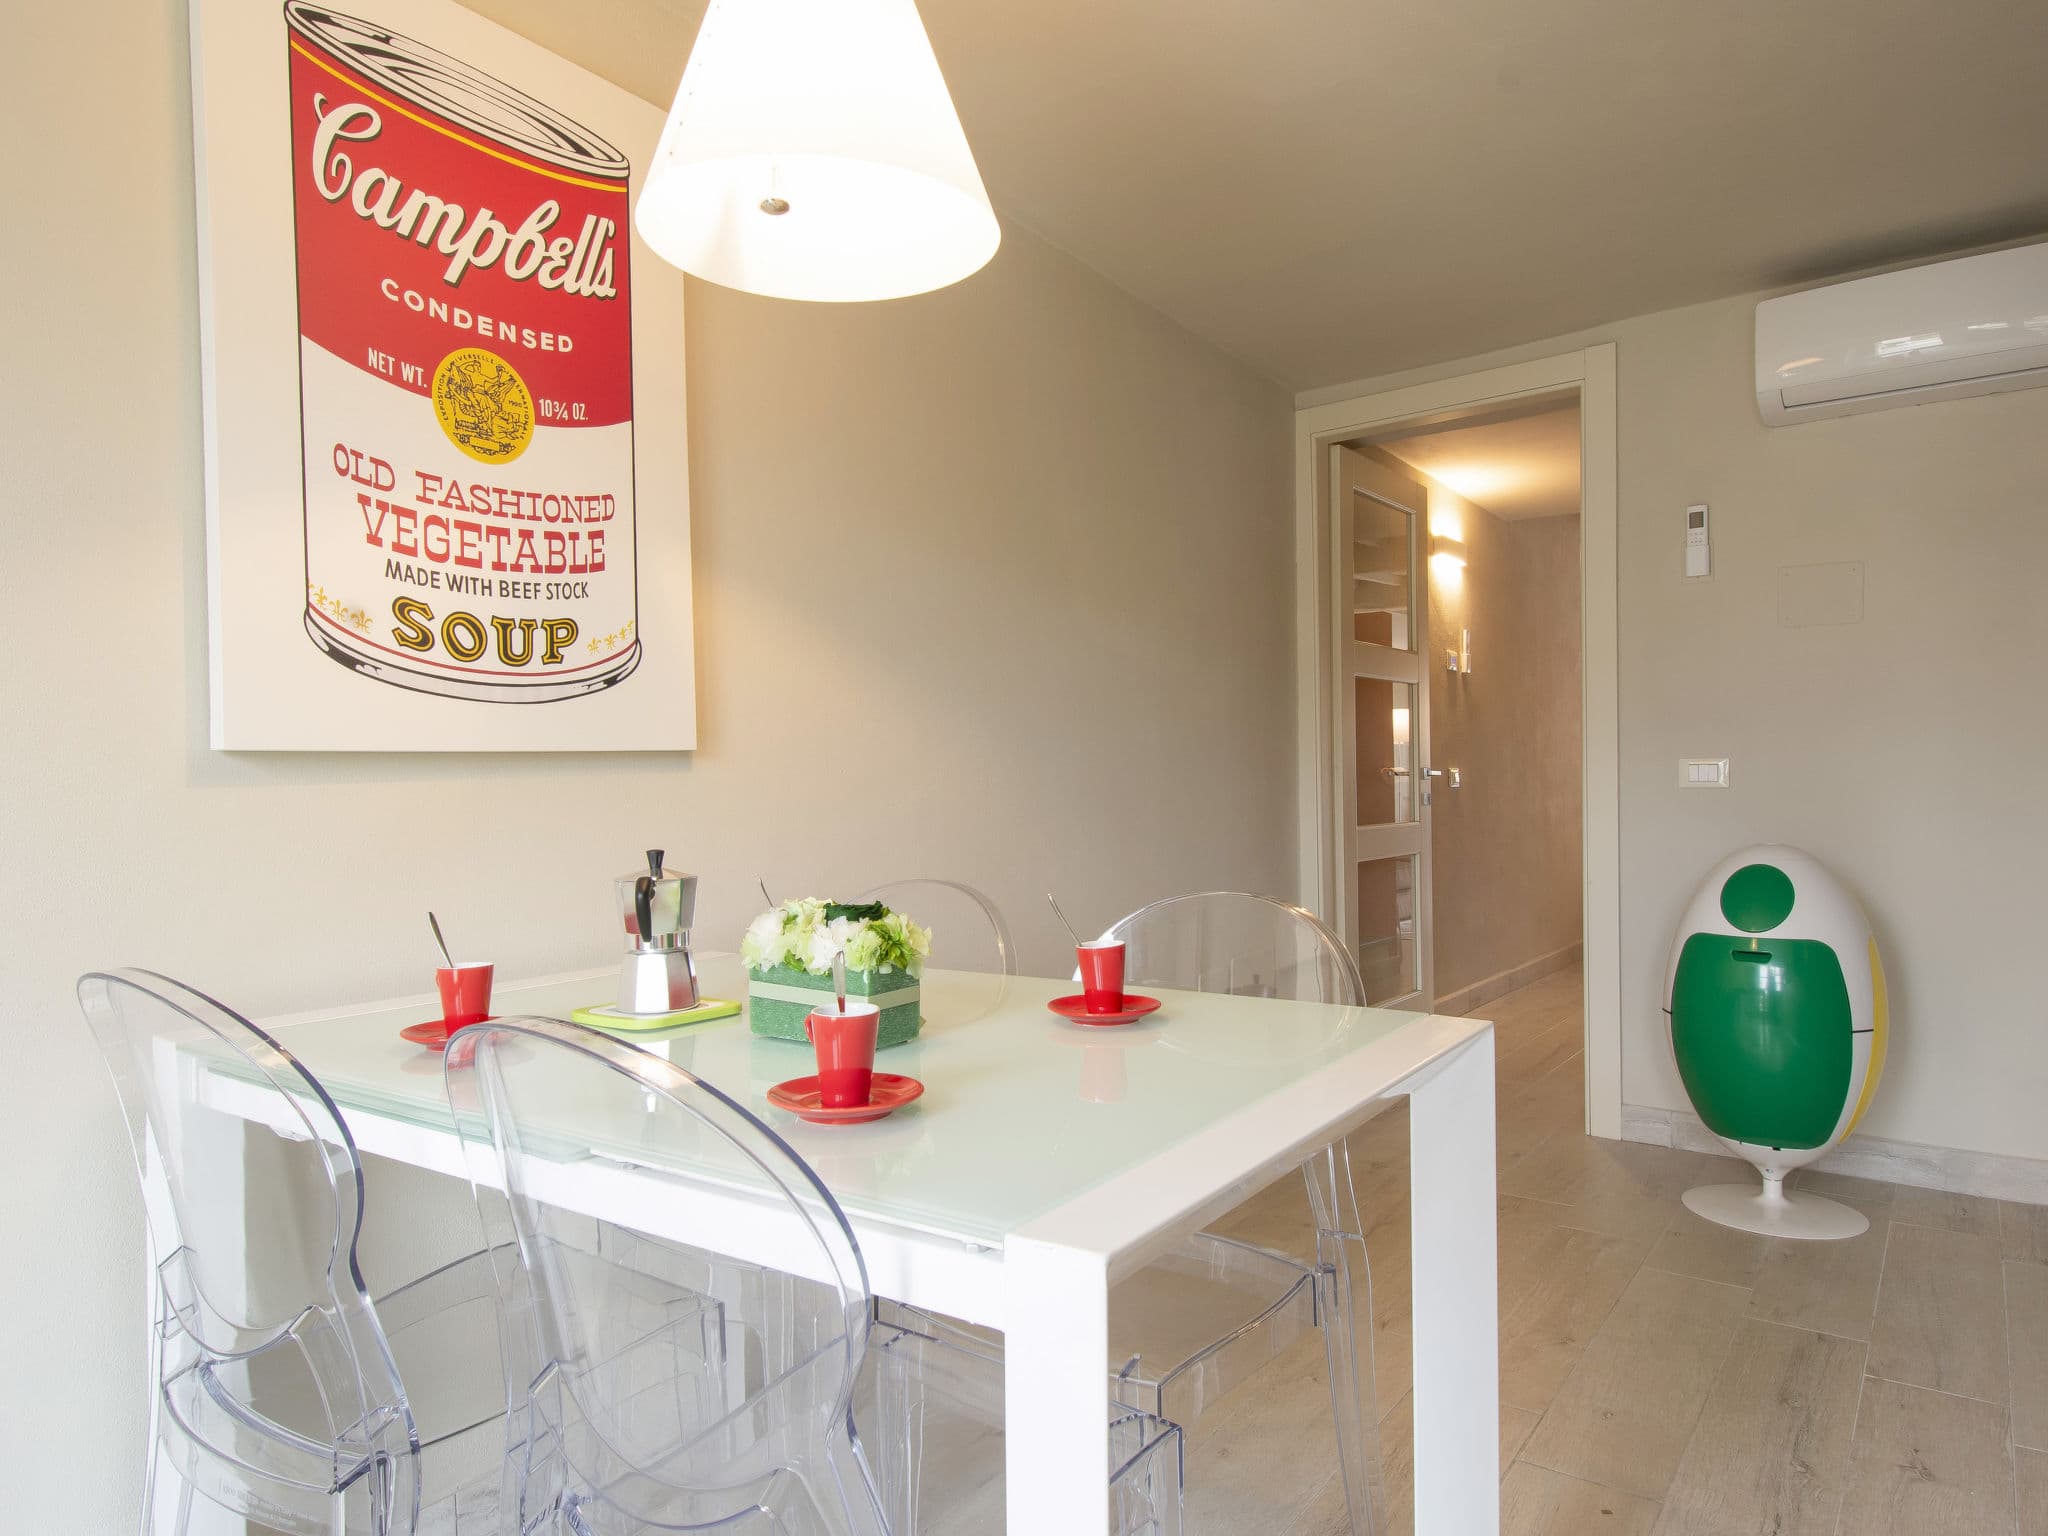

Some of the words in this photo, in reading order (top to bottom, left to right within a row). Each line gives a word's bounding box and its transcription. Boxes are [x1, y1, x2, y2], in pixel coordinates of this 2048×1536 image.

[313, 92, 617, 298] Campbell's
[381, 278, 574, 353] CONDENSED
[368, 347, 395, 376] NET
[401, 361, 428, 388] WT.
[572, 402, 589, 420] OZ.
[333, 443, 396, 492] OLD
[415, 470, 615, 524] FASHIONED
[357, 493, 606, 574] VEGETABLE
[385, 558, 440, 590] MADE
[446, 572, 492, 597] WITH
[499, 579, 541, 600] BEEF
[546, 581, 589, 600] STOCK
[391, 596, 579, 666] SOUP
